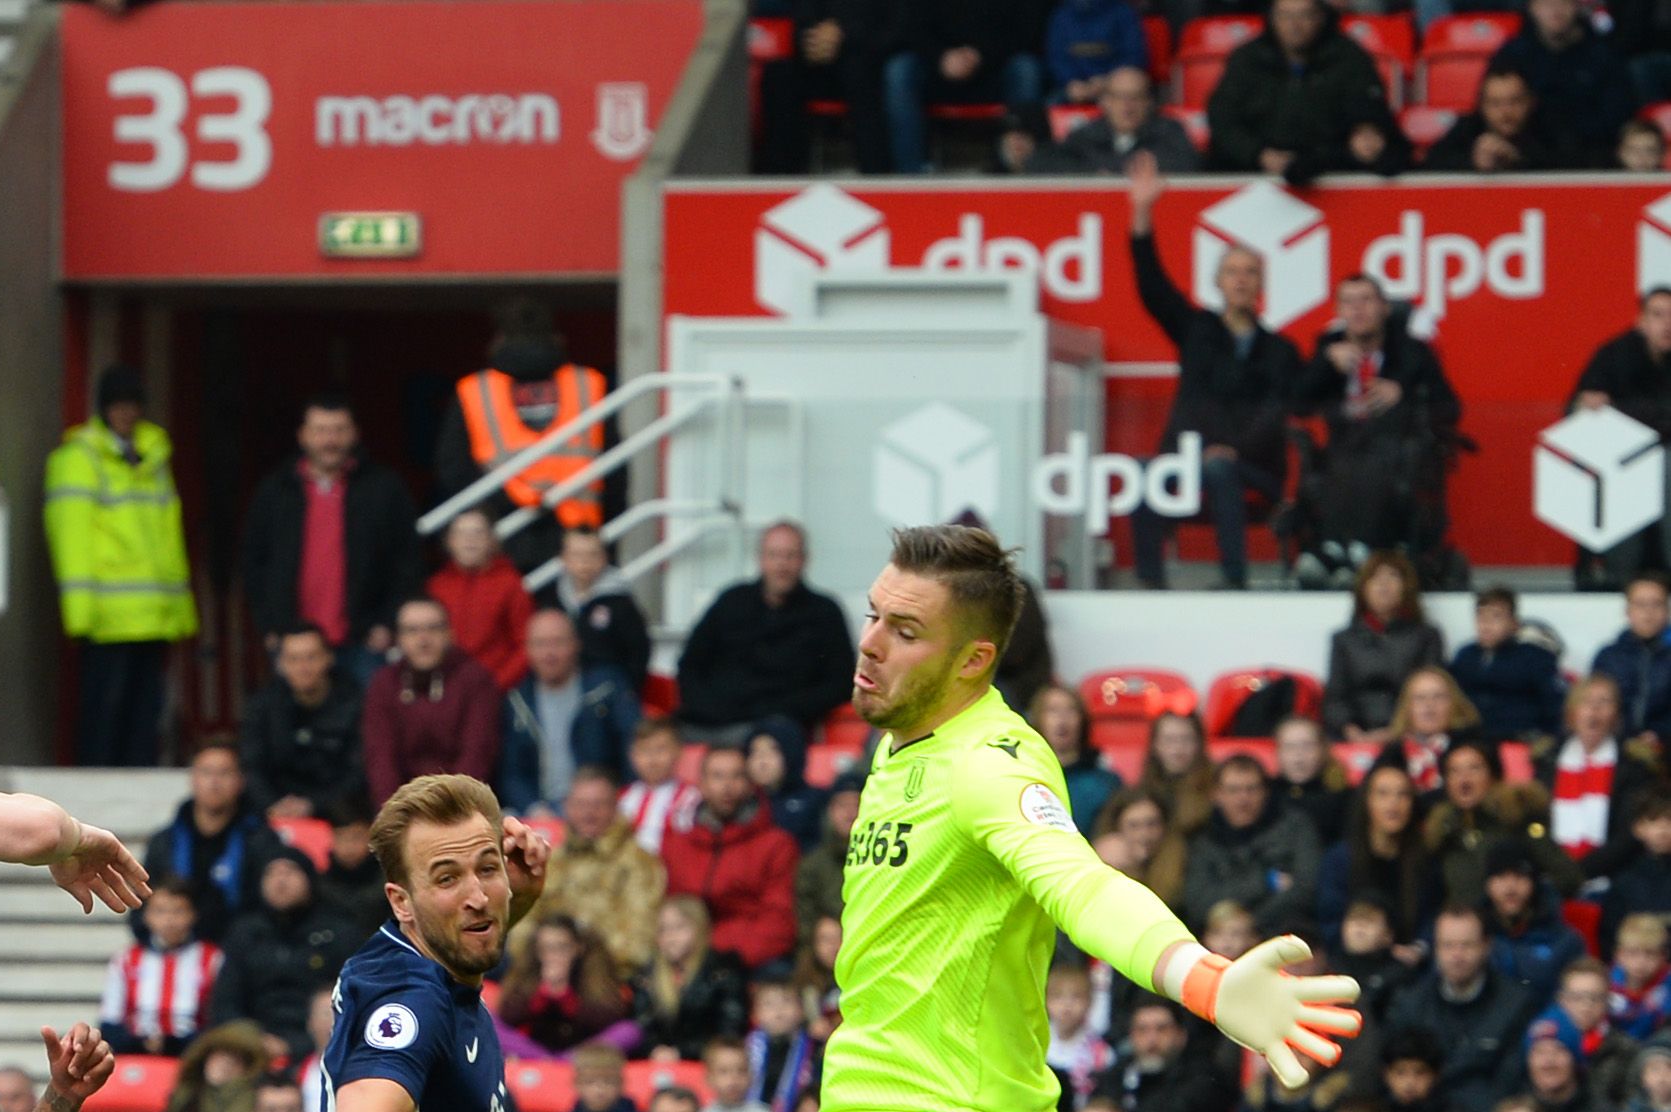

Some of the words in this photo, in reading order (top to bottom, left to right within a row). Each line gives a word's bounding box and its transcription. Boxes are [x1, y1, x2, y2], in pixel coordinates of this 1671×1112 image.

[107, 66, 272, 191] 33
[315, 93, 561, 146] macron
[1362, 208, 1545, 320] dpd
[1032, 429, 1202, 535] dpd
